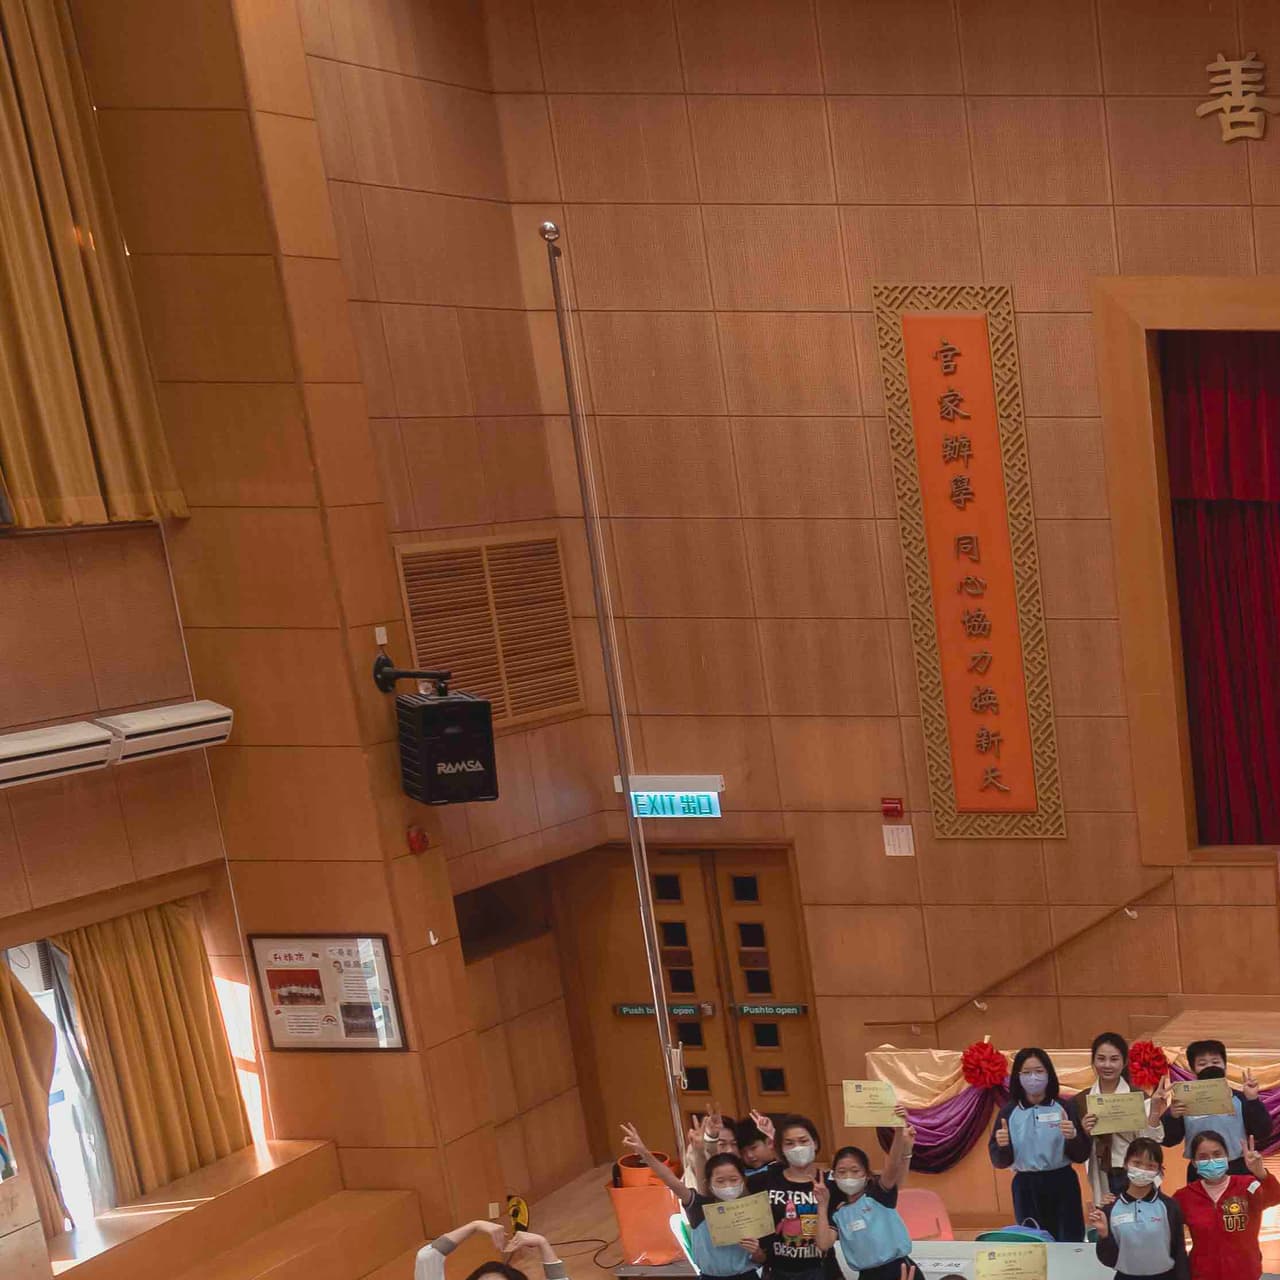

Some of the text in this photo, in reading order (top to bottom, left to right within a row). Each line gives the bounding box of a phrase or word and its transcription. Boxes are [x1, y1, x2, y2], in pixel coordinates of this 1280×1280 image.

[437, 760, 485, 775] RAMSA
[633, 794, 713, 816] EXIT 出口
